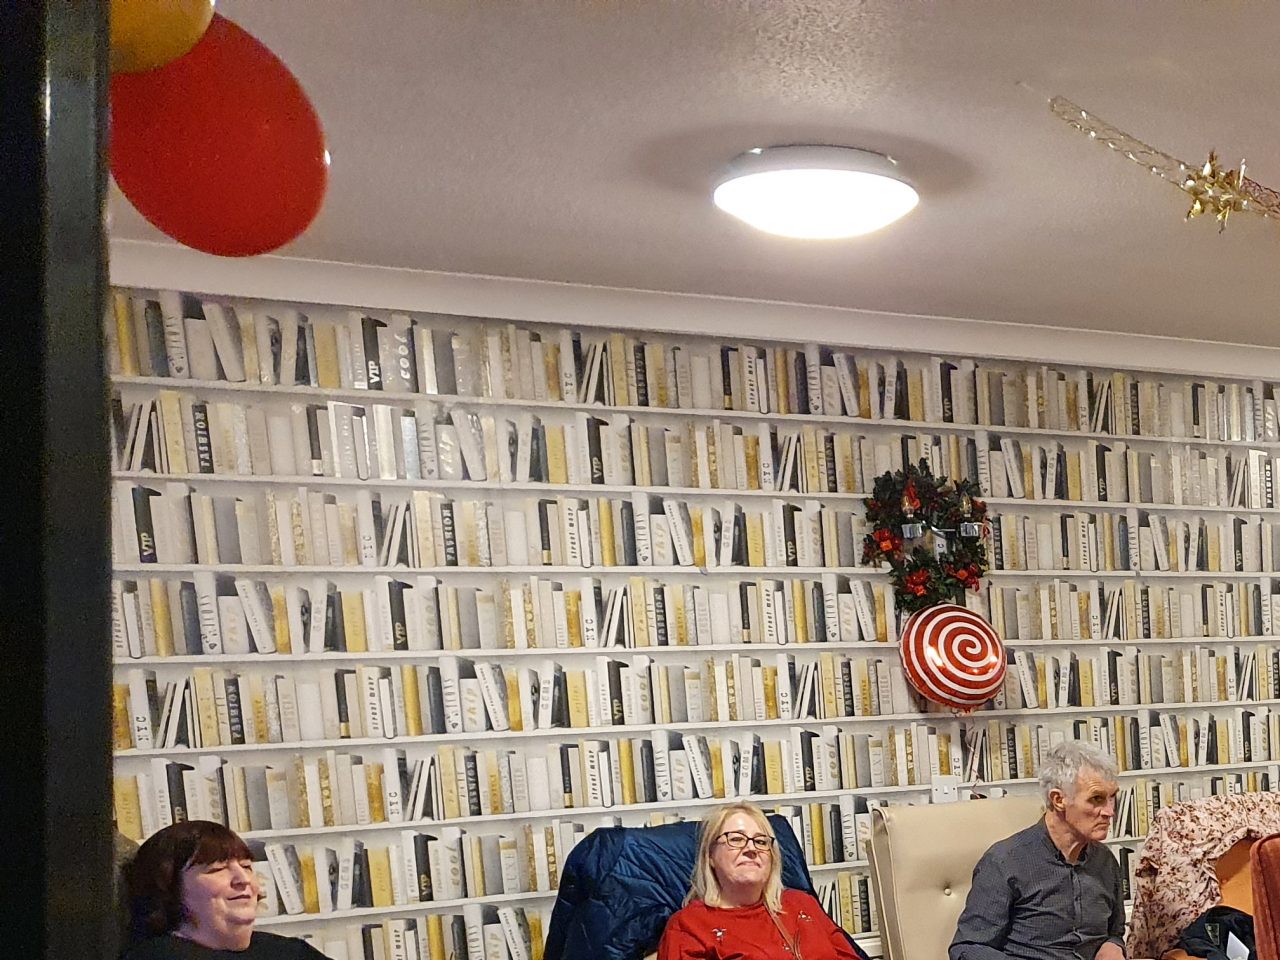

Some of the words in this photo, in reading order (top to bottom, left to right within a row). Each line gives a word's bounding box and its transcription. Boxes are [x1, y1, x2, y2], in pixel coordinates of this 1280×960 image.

[368, 360, 380, 384] VIP
[194, 411, 211, 467] FASHION
[592, 457, 604, 479] VIP
[141, 532, 154, 556] VIP
[442, 508, 457, 562] FASHION
[655, 592, 667, 641] FASHION
[395, 622, 407, 645] VIP
[585, 617, 595, 642] NYC
[227, 684, 243, 740] FASHION
[613, 698, 624, 720] VIP
[136, 715, 150, 742] NYC
[1007, 732, 1017, 780] FASHION
[806, 766, 815, 786] VIP
[419, 872, 432, 896] VIP
